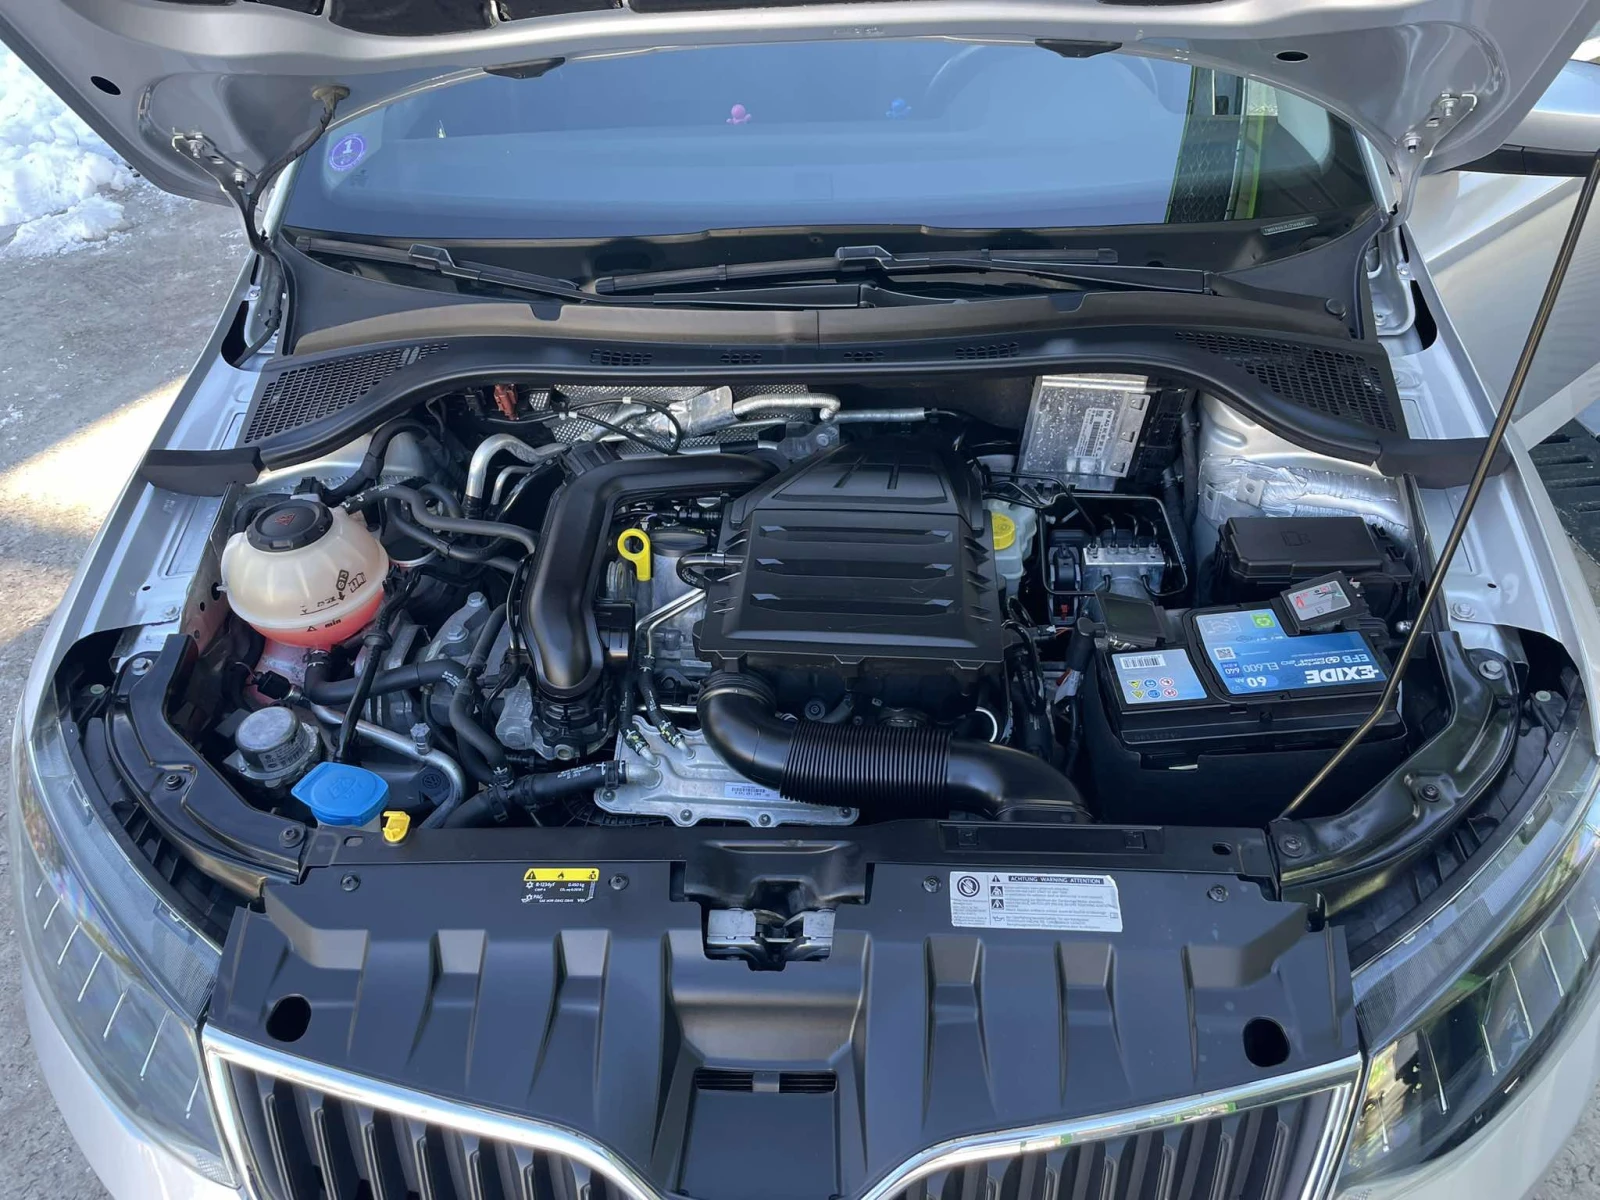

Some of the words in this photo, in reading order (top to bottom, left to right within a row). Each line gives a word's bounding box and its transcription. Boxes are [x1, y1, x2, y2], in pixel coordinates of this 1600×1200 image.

[342, 139, 353, 155] 1
[325, 619, 341, 628] min
[1342, 653, 1370, 664] EFB
[1242, 662, 1279, 673] EL600
[1304, 665, 1379, 684] EXIDE
[1246, 676, 1267, 687] 60
